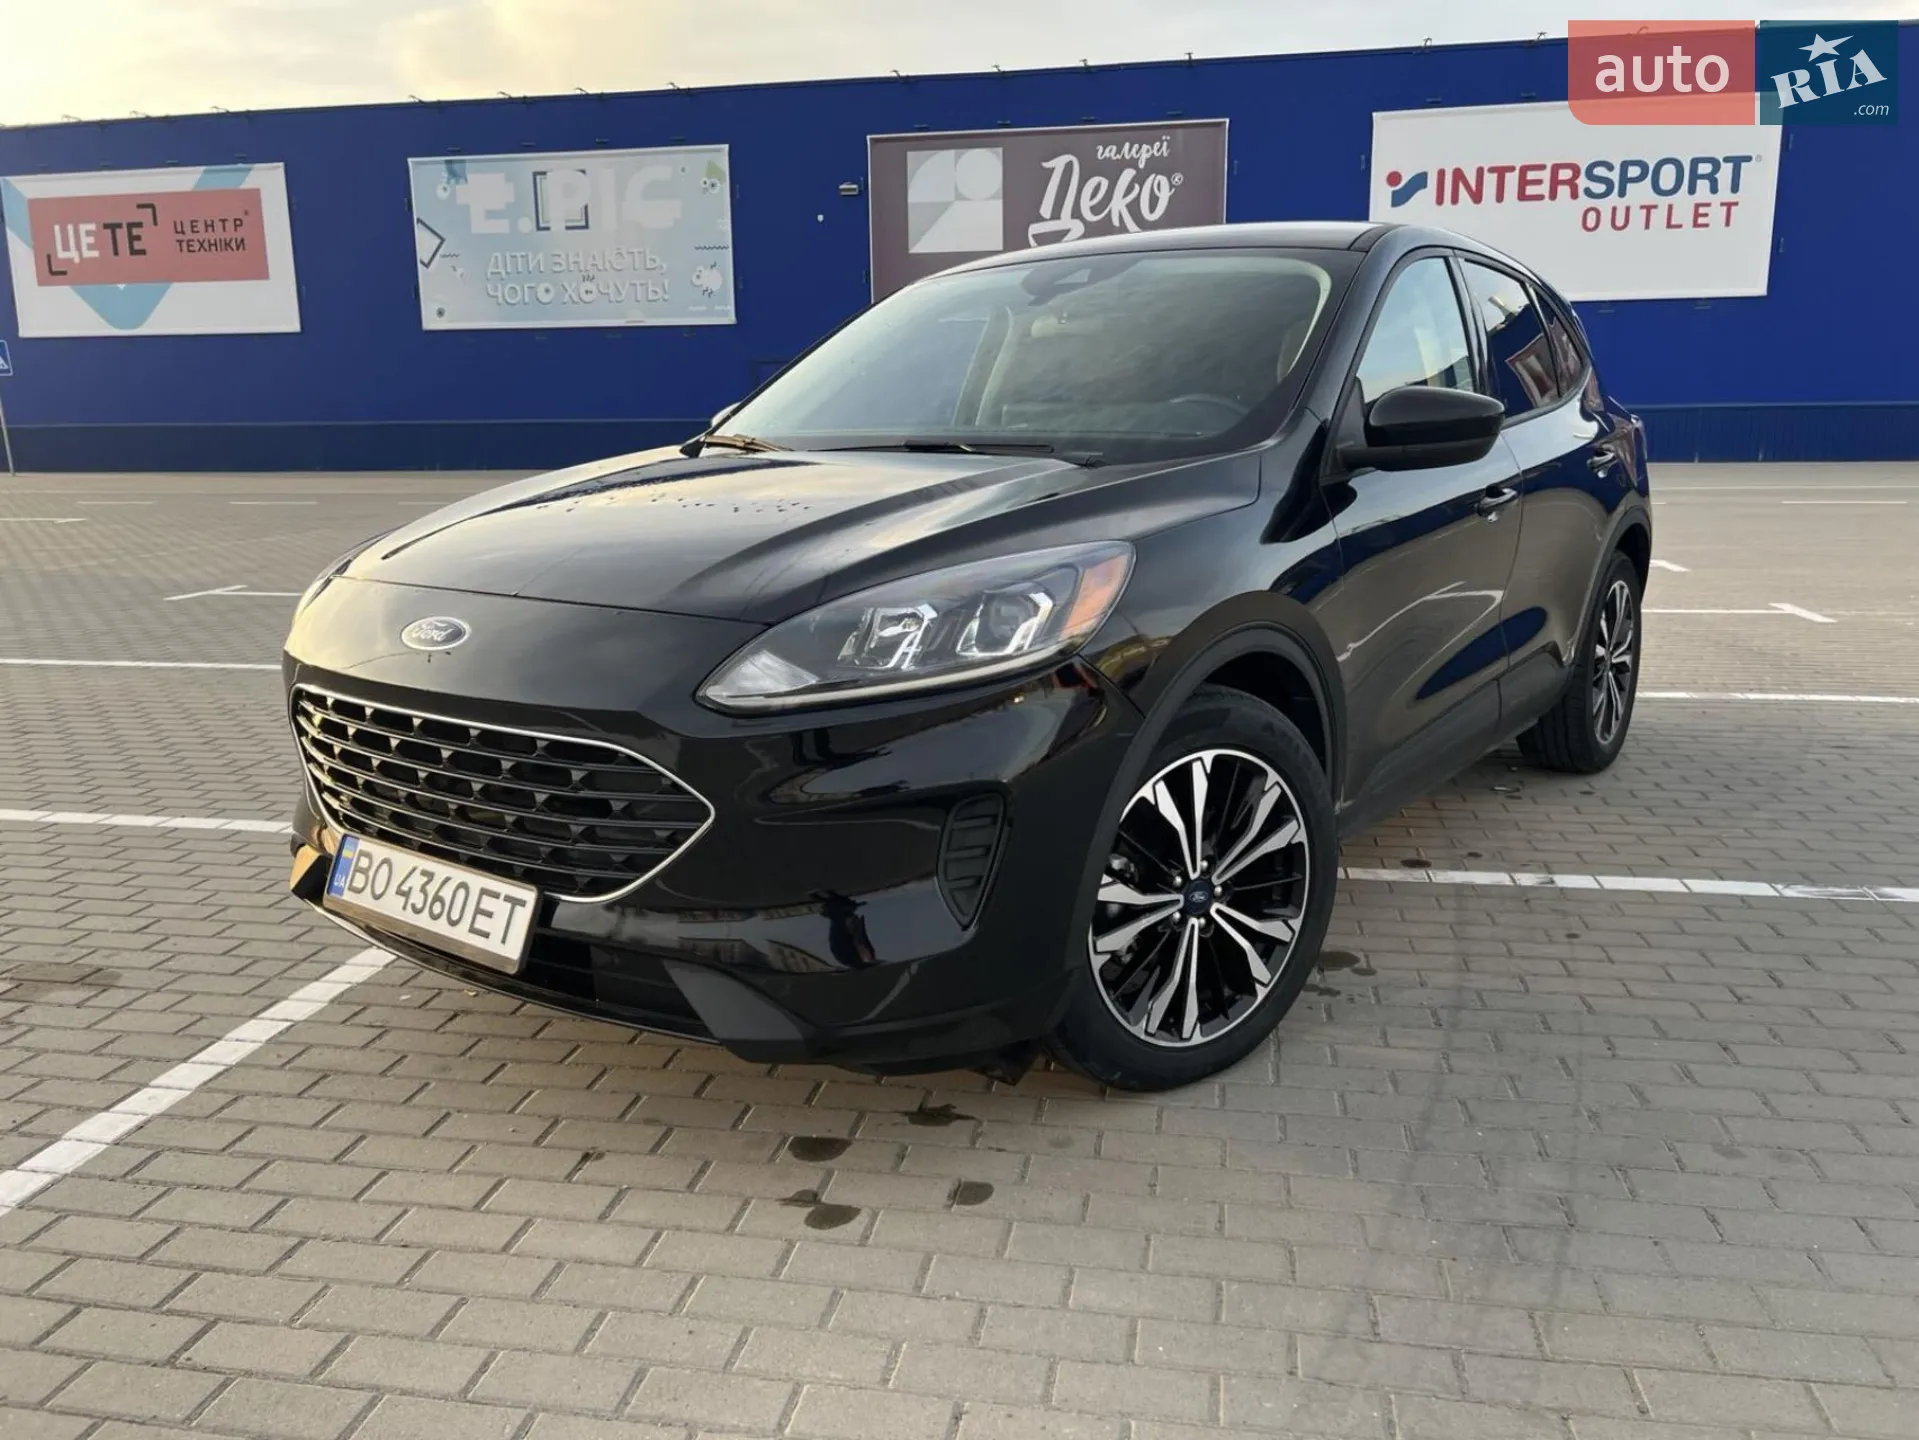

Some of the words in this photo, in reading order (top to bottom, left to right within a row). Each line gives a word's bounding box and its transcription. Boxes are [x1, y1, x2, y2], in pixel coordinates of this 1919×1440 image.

[1096, 135, 1171, 169] галереї
[1435, 155, 1753, 206] INTERSPORT
[173, 218, 244, 235] ЦЕНТР
[1581, 201, 1739, 232] OUTLET
[176, 238, 246, 253] ТЕХНІКИ
[486, 251, 545, 281] ДІТИ
[486, 283, 554, 306] ЧОГО
[560, 279, 670, 306] ХОЧУТЬ!
[411, 620, 455, 642] Ford
[395, 866, 470, 927] 4360
[468, 887, 527, 945] ET
